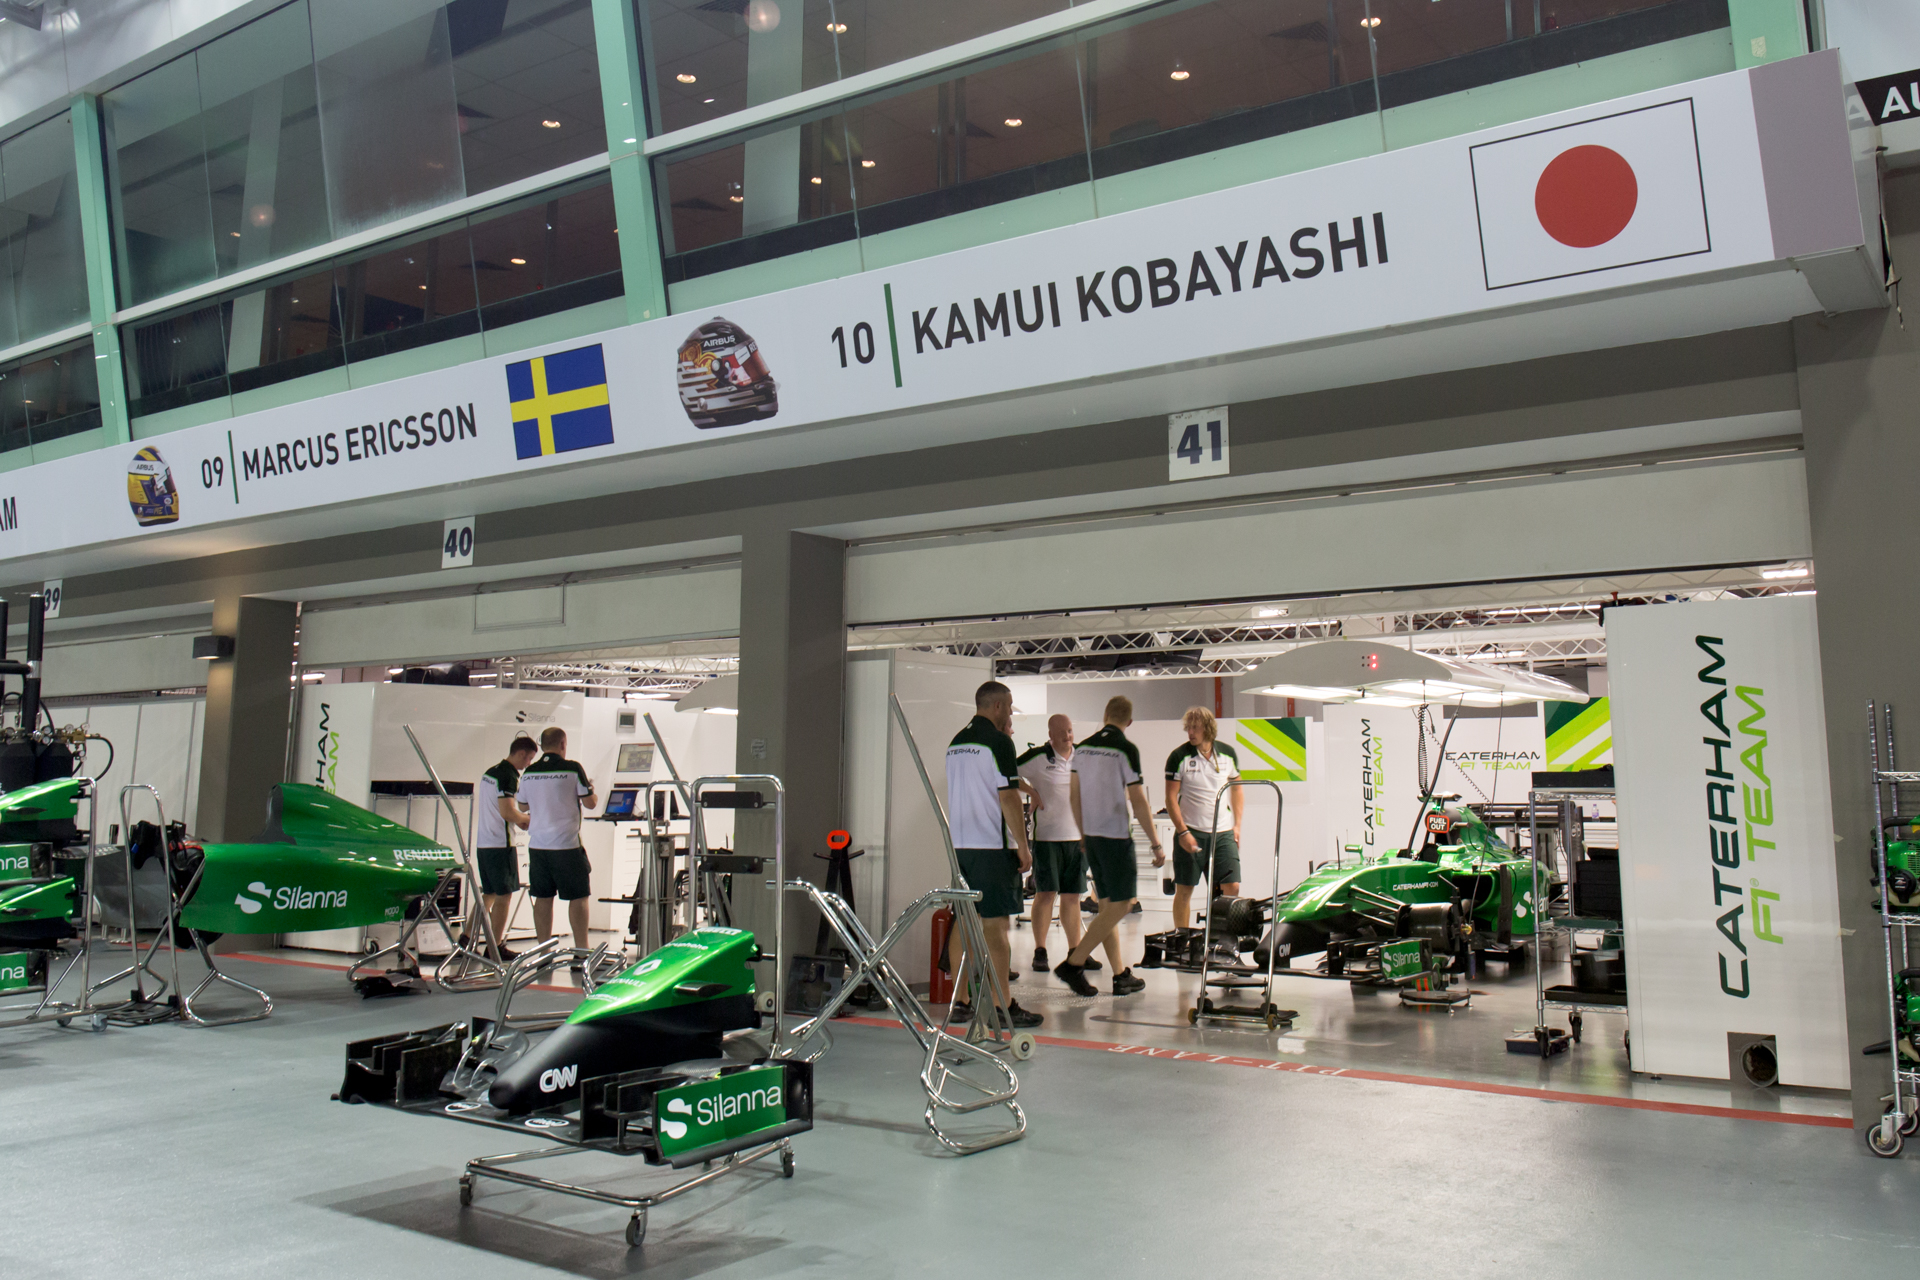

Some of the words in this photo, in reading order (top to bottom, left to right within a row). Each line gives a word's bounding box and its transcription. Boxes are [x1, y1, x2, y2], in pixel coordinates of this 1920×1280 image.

[831, 321, 875, 368] 10
[911, 281, 1061, 354] KAMUI
[1076, 211, 1389, 322] KOBAYASHI
[703, 335, 735, 348] AIRBUS
[201, 457, 224, 488] 09
[242, 432, 340, 481] MARCUS
[346, 403, 478, 461] ERICSSON
[1177, 420, 1222, 465] 41
[444, 527, 473, 557] 40
[44, 587, 60, 611] 39
[1373, 736, 1384, 799] TEAM
[1460, 762, 1474, 770] F1
[1482, 762, 1531, 770] TEAM
[1734, 685, 1776, 861] TEAM
[1361, 718, 1375, 845] CATERHAM
[1375, 804, 1386, 827] F1
[1429, 817, 1447, 825] FUEL
[1430, 823, 1445, 831] OUT
[1694, 635, 1750, 999] CATERHAM
[393, 849, 451, 861] RENAULT
[273, 884, 348, 911] Silanna
[539, 1064, 578, 1093] CNN
[697, 1086, 782, 1126] Silanna
